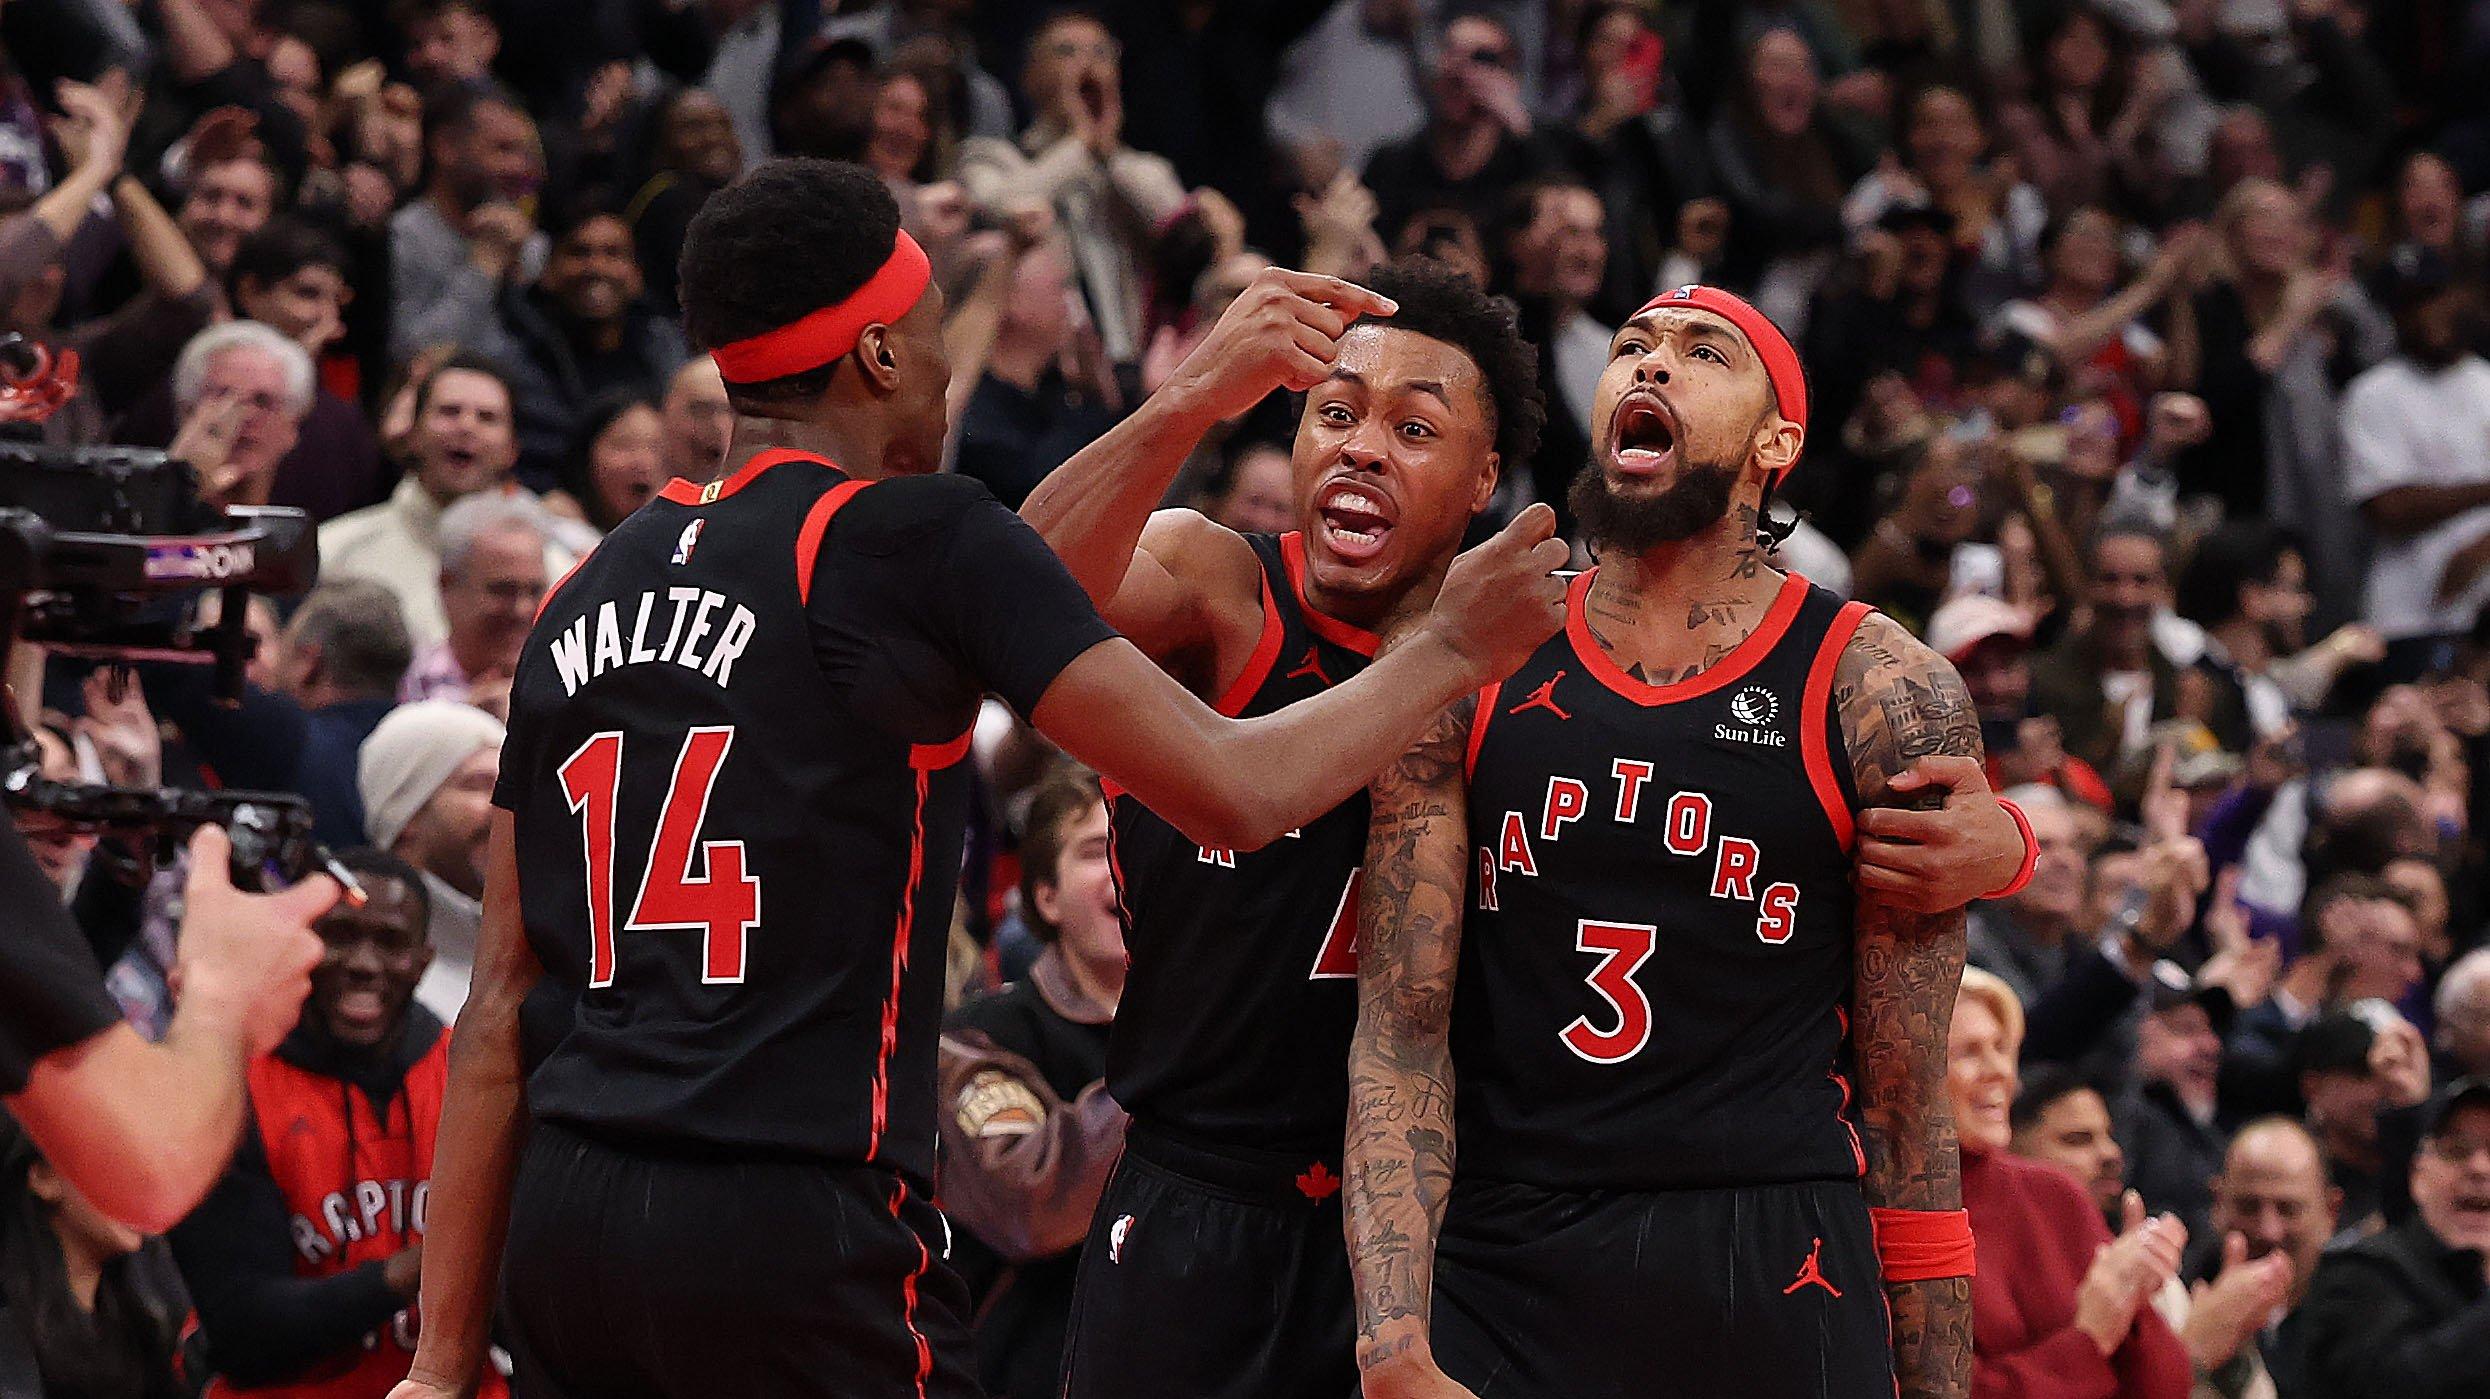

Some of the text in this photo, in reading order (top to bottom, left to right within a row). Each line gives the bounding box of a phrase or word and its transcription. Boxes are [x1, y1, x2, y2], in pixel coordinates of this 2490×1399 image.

[550, 586, 756, 697] WALTER
[1714, 723, 1786, 747] Sun Life
[557, 725, 761, 989] 14
[1479, 757, 1800, 945] RAPTORS
[1558, 919, 1657, 1064] 3
